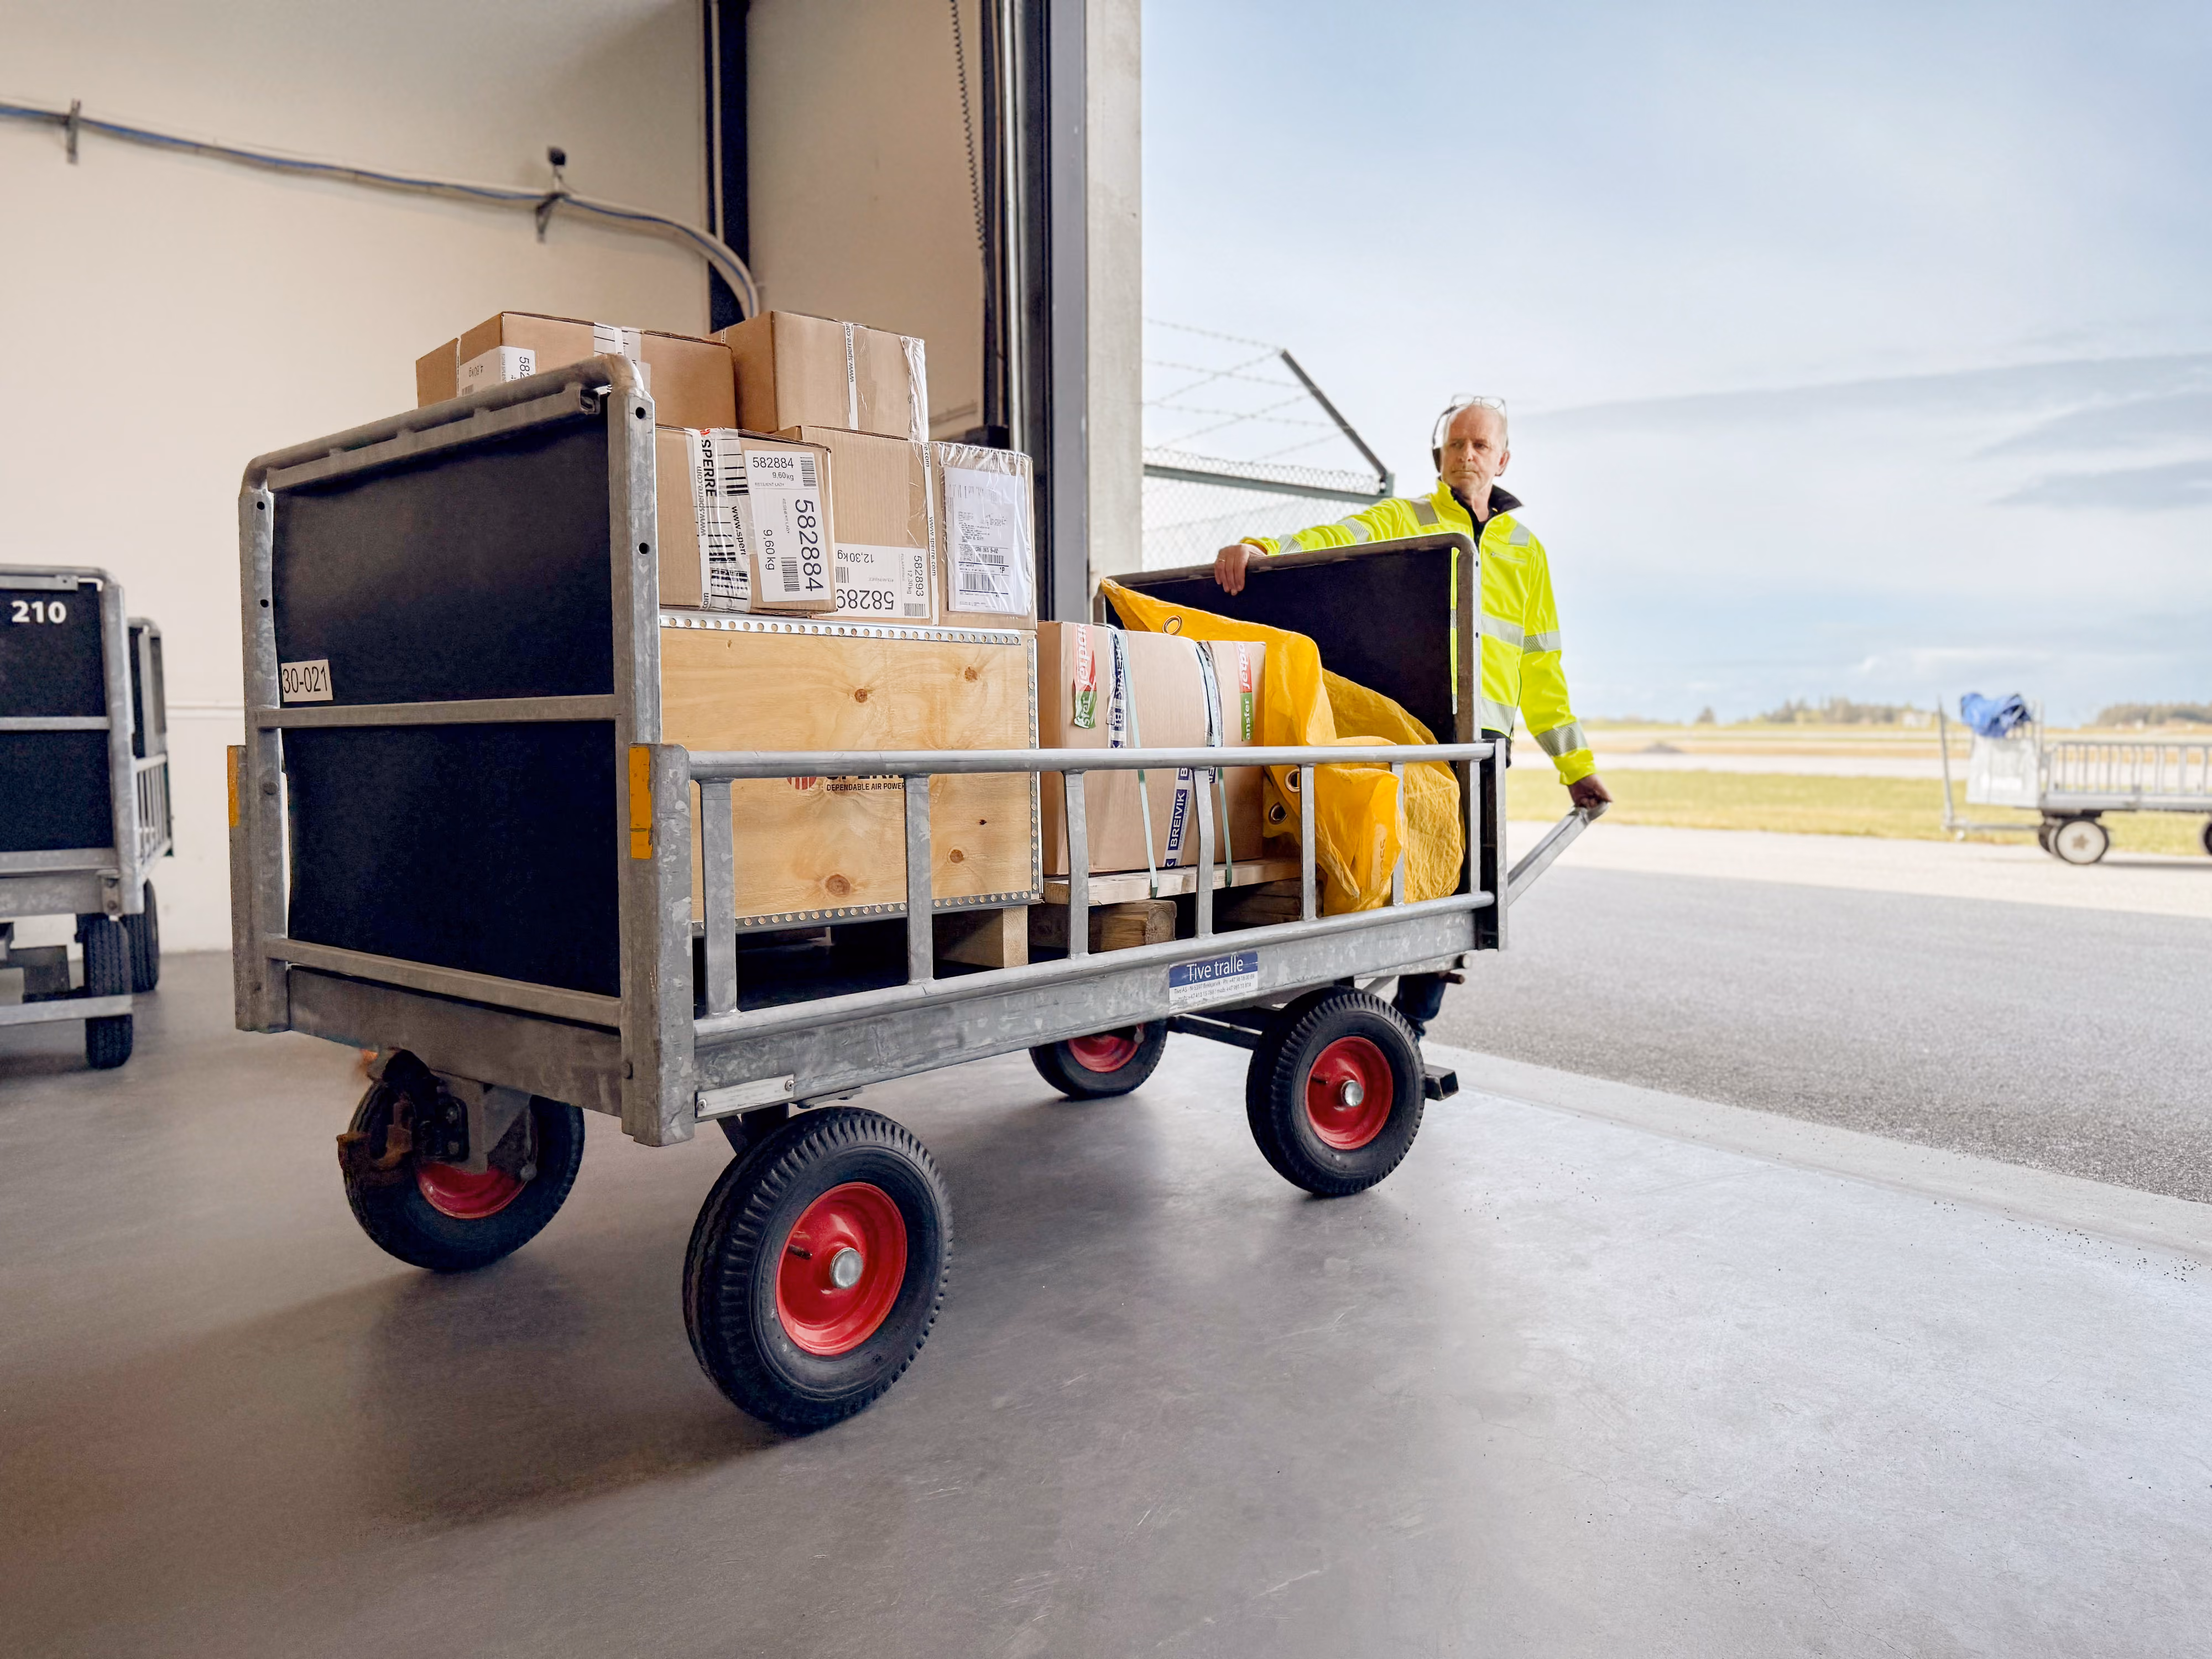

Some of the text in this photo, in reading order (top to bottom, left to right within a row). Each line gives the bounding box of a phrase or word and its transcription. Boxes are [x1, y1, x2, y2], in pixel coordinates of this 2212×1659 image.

[701, 439, 718, 497] SPERRE
[753, 457, 794, 468] 582884
[696, 466, 707, 536] www.sperre.com
[795, 499, 824, 592] 582884
[914, 555, 924, 597] 582893
[11, 600, 67, 624] 210
[283, 666, 327, 693] 30-021
[827, 783, 870, 791] DEPENDABLE
[1170, 792, 1185, 847] BREIVIK
[1187, 955, 1244, 981] Tive tralle
